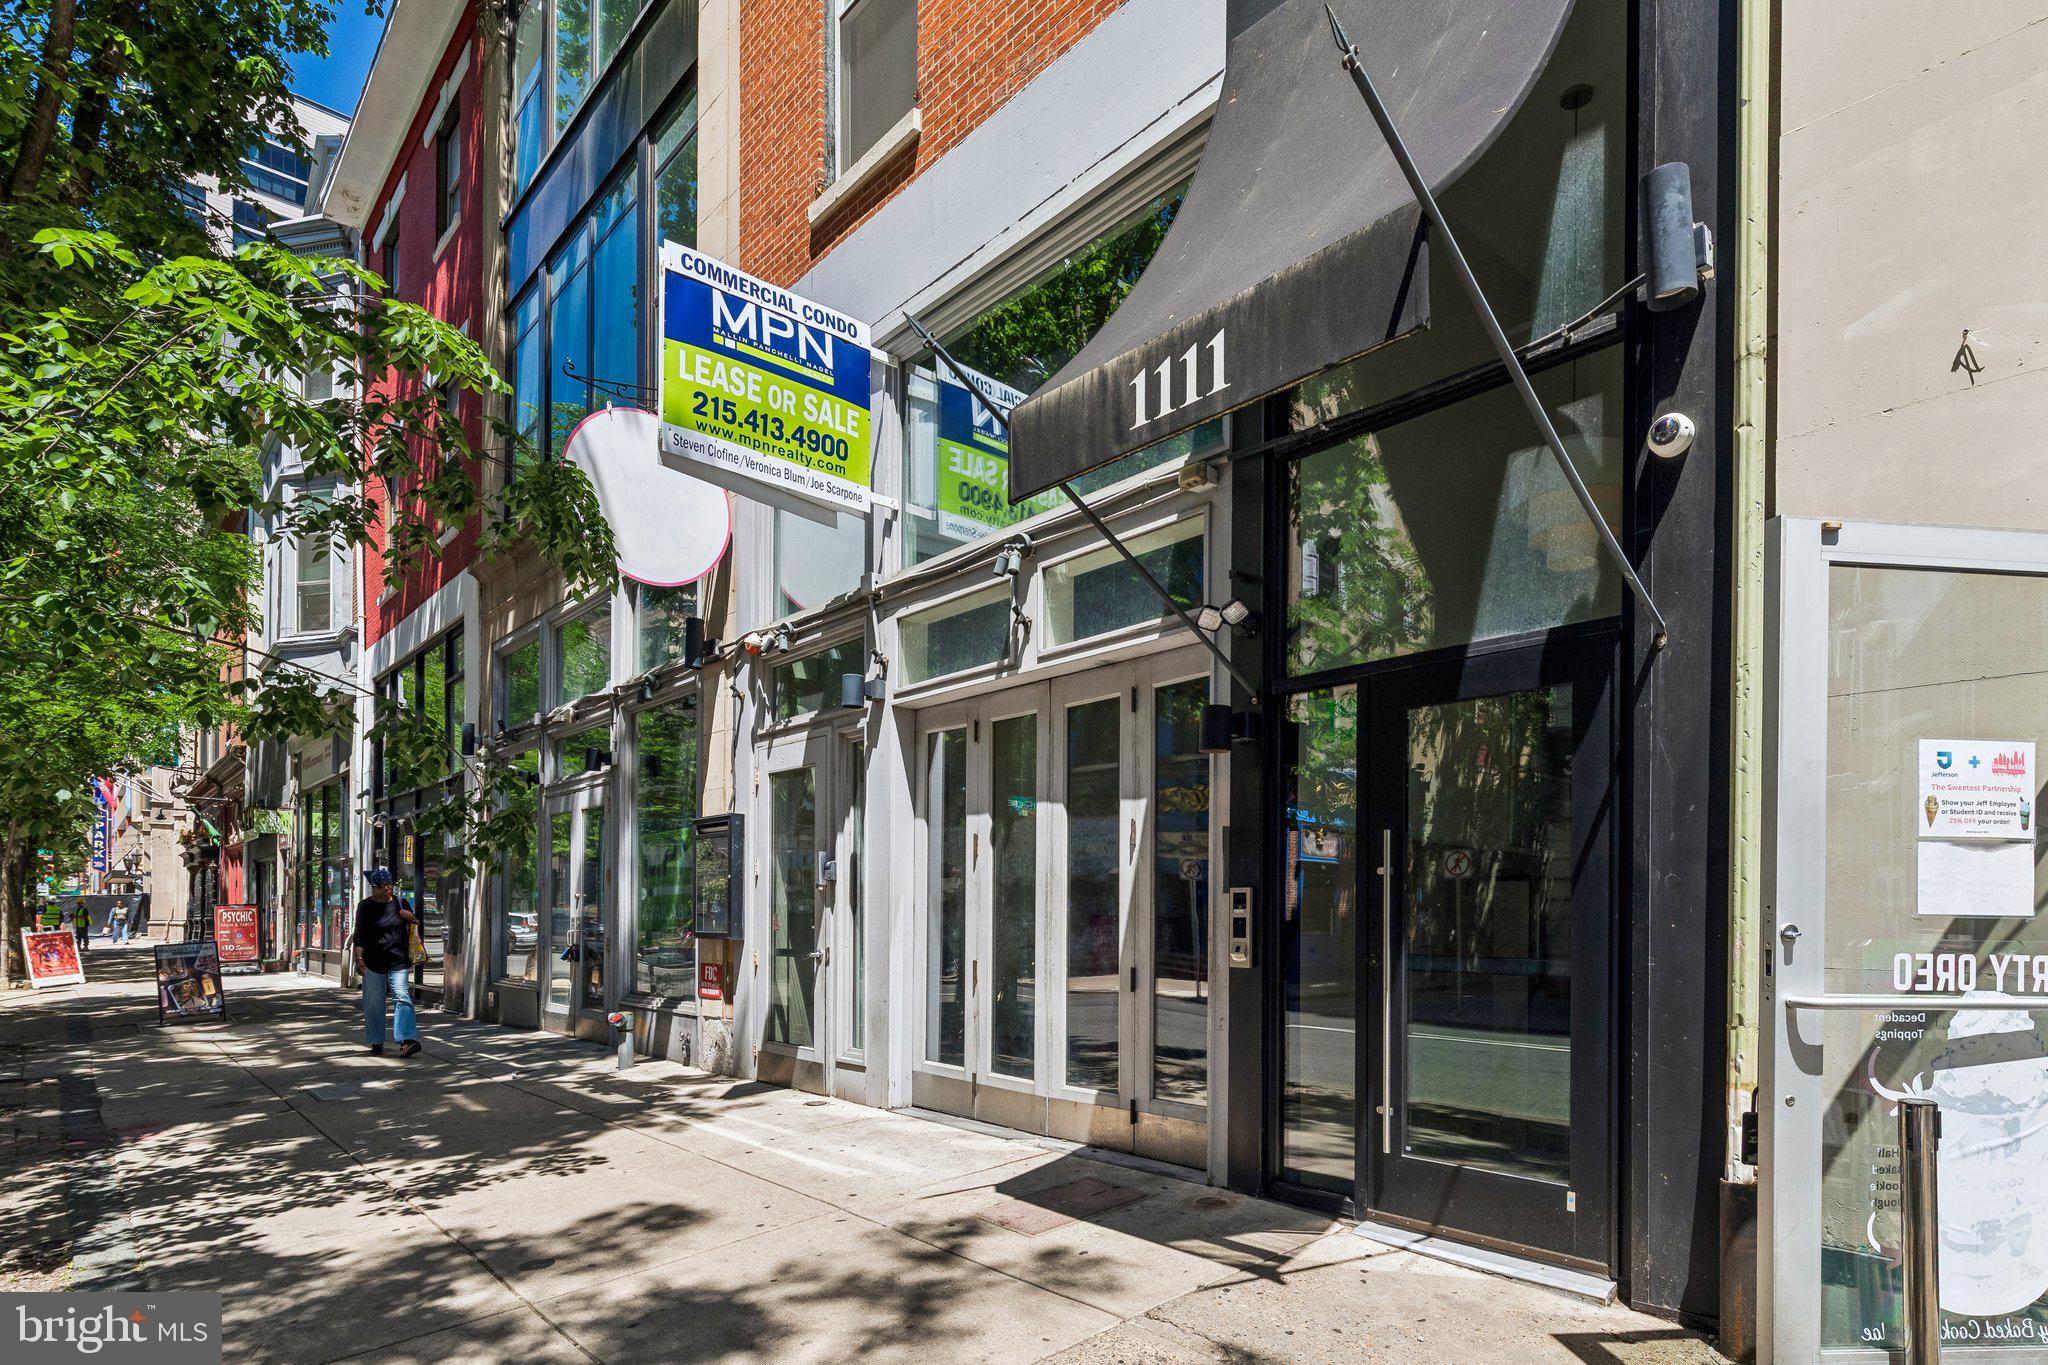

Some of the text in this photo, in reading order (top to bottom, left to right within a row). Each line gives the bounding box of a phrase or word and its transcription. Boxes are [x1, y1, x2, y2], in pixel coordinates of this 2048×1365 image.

[681, 253, 857, 339] COMMERCIAL CONDO
[712, 289, 834, 369] MPN
[713, 326, 748, 344] MALLIN
[806, 362, 834, 376] NADEL
[1129, 328, 1231, 430] 1111
[679, 349, 859, 438] LEASE OR SALE
[692, 391, 849, 462] 215.413.4900
[673, 433, 705, 455] Steven
[826, 482, 862, 503] Scarpone
[695, 419, 846, 476] www.mpnrealty.com
[1947, 784, 1981, 792] Sweetest
[1982, 785, 2022, 793] Partnership
[94, 821, 105, 858] PARK
[222, 911, 253, 922] PSYCHIC
